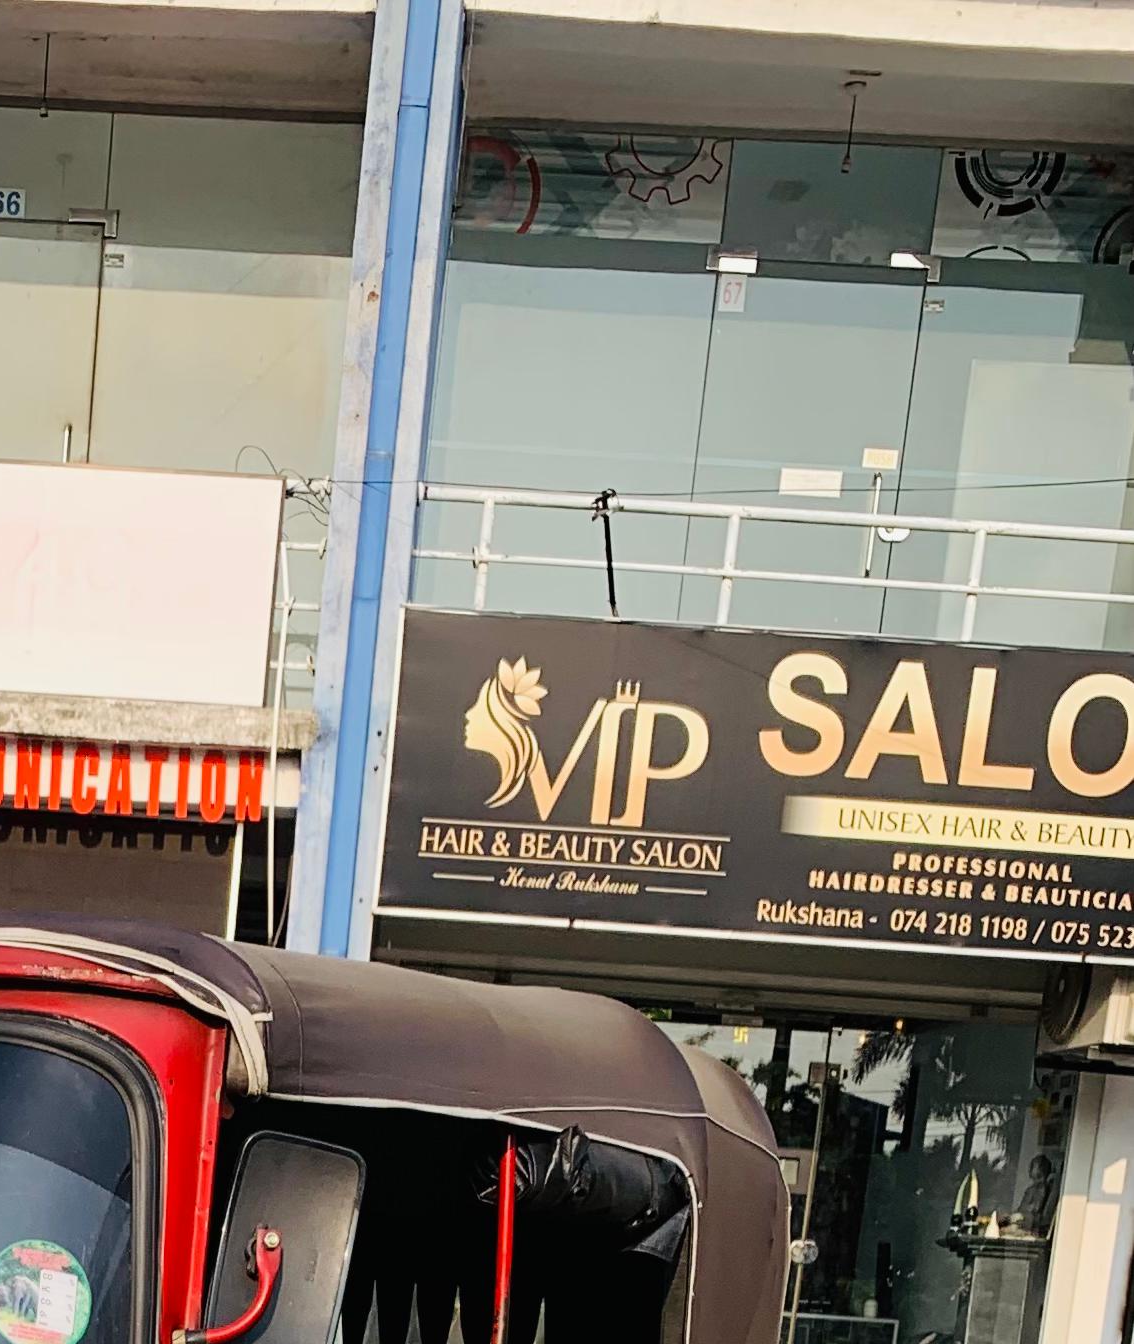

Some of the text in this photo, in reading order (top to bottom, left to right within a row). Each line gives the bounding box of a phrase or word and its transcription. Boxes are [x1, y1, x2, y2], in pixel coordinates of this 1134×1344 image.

[723, 281, 743, 305] 67
[526, 698, 710, 828] VIP
[420, 826, 722, 871] HAIR & BEAUTY SALON
[838, 808, 1134, 850] UNISEX HAIR & BEAUTY
[892, 851, 1073, 884] PROFESSIONAL
[808, 870, 1134, 913] HAIRDRESSER & BEAUTICIA
[756, 899, 864, 930] Rukshana
[890, 909, 927, 933] 074
[934, 911, 971, 936] 218
[981, 915, 1028, 941] 1198
[1032, 919, 1046, 945] /
[1051, 920, 1090, 946] 075
